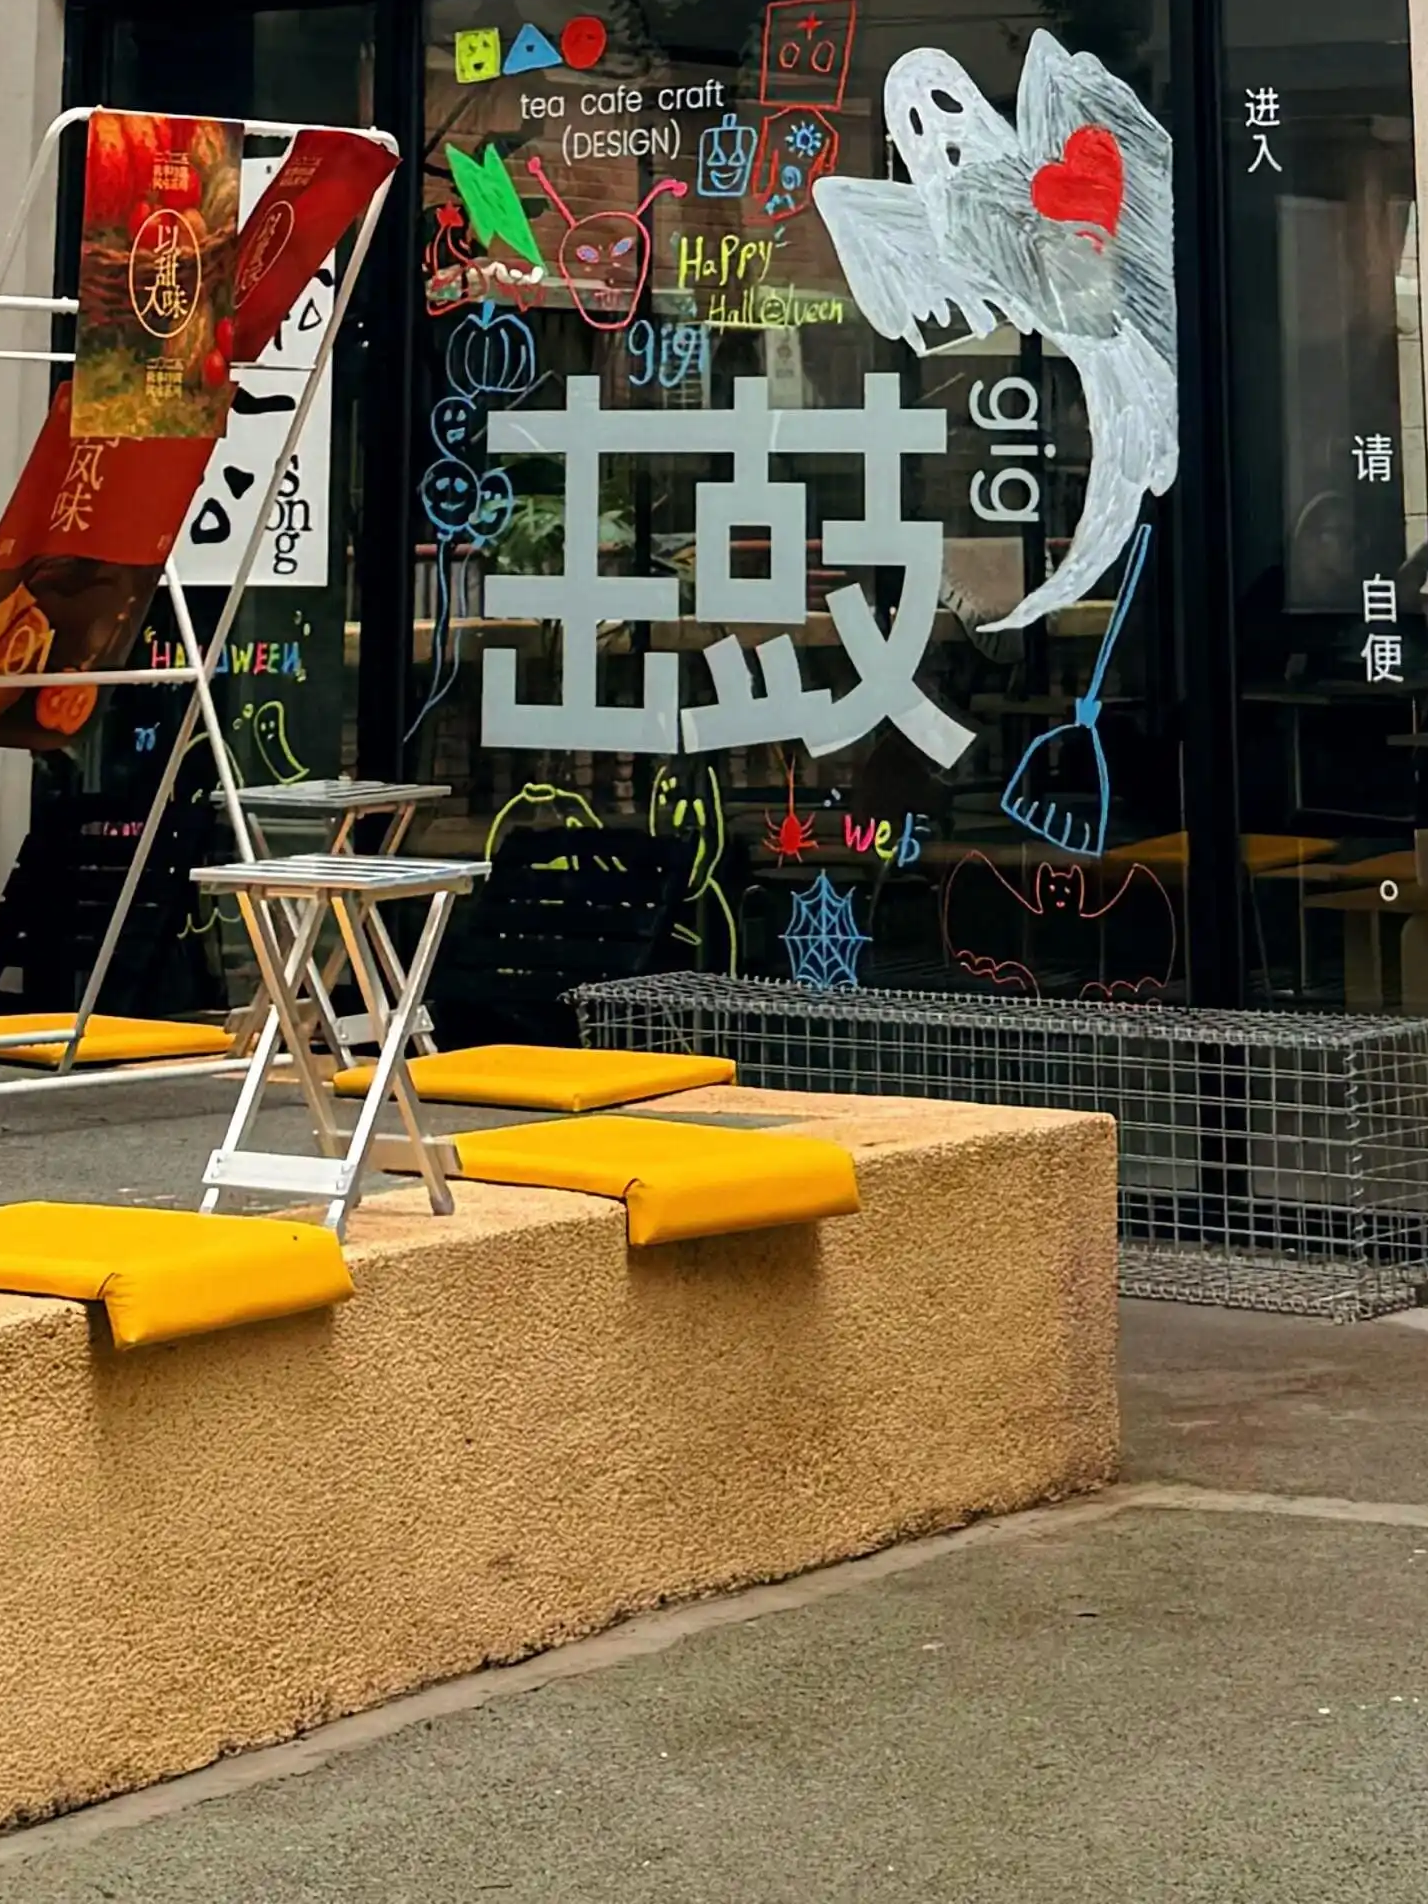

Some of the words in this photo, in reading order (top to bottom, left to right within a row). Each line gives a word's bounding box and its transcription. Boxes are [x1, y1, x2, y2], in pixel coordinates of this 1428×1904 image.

[520, 93, 566, 121] tea
[581, 85, 643, 115] cafe
[658, 79, 725, 112] craft
[1244, 87, 1283, 174] 进入
[562, 122, 682, 165] (DESIGN)
[49, 437, 122, 533] 风味
[970, 375, 1057, 524] gig
[844, 811, 921, 868] web
